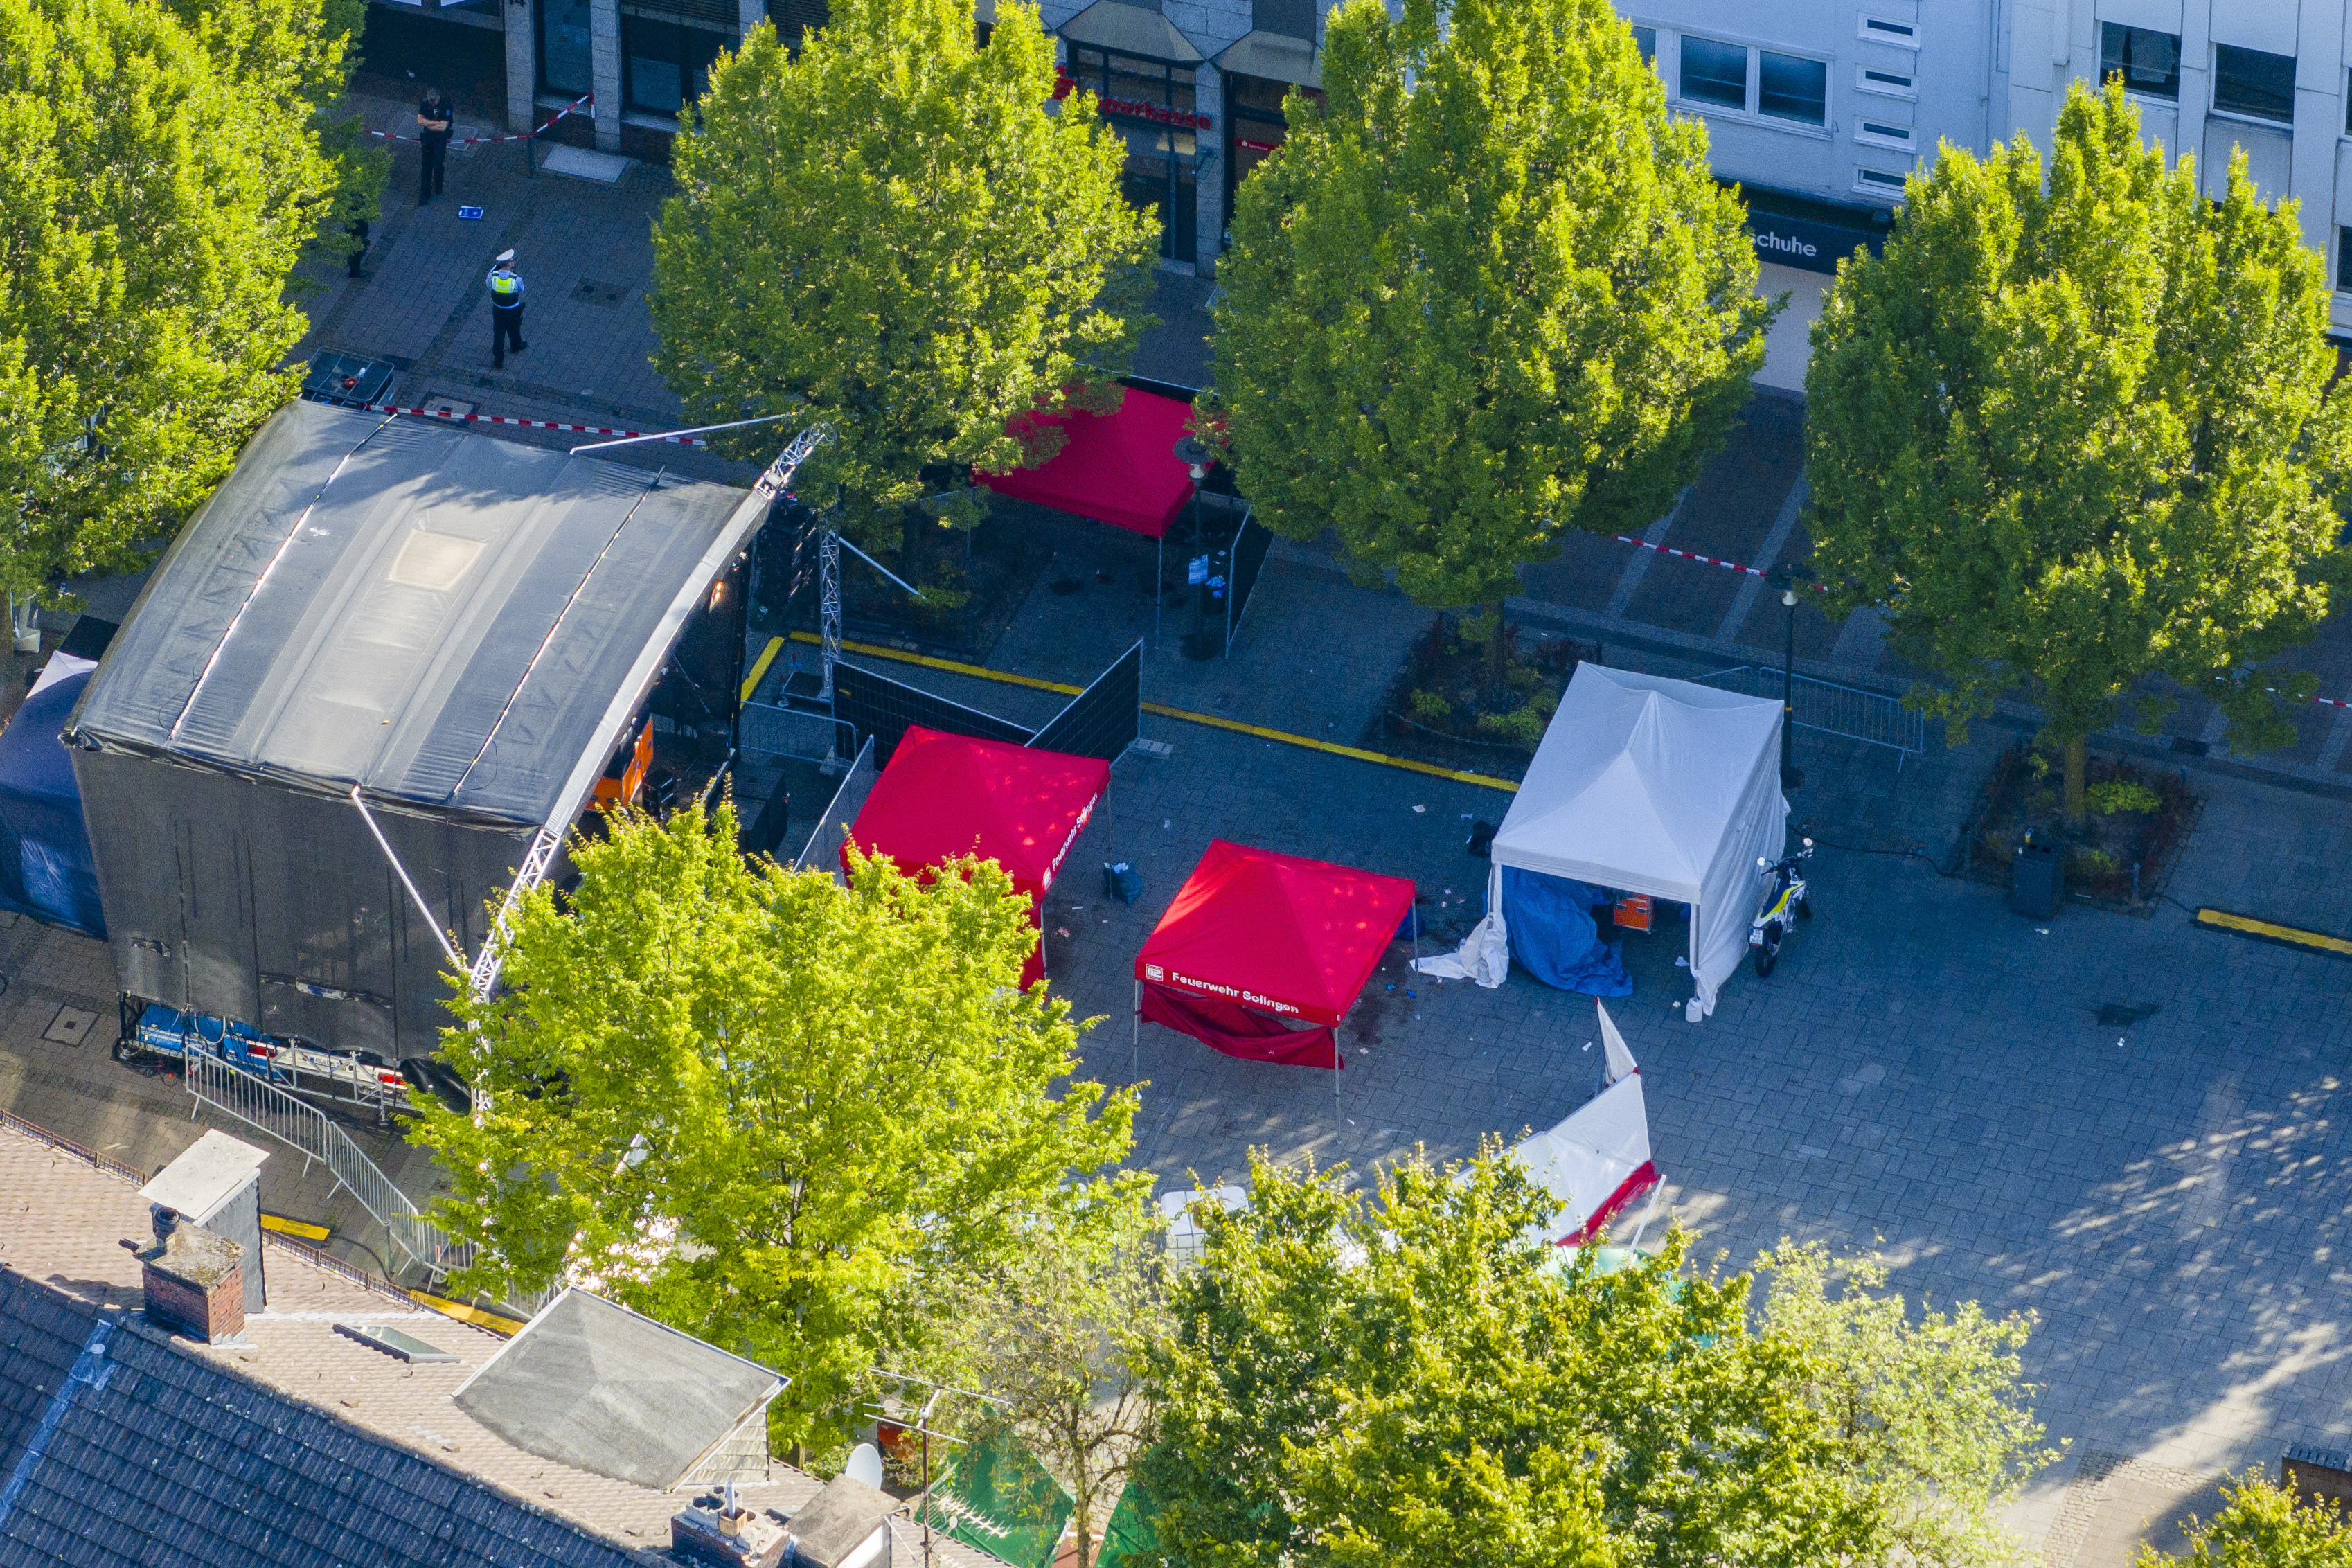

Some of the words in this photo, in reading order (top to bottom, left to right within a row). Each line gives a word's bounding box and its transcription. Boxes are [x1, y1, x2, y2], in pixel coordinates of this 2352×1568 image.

[1052, 825, 1077, 871] Feuerwehr
[1172, 972, 1240, 998] Feuerwehr
[1242, 990, 1299, 1014] Solingen
